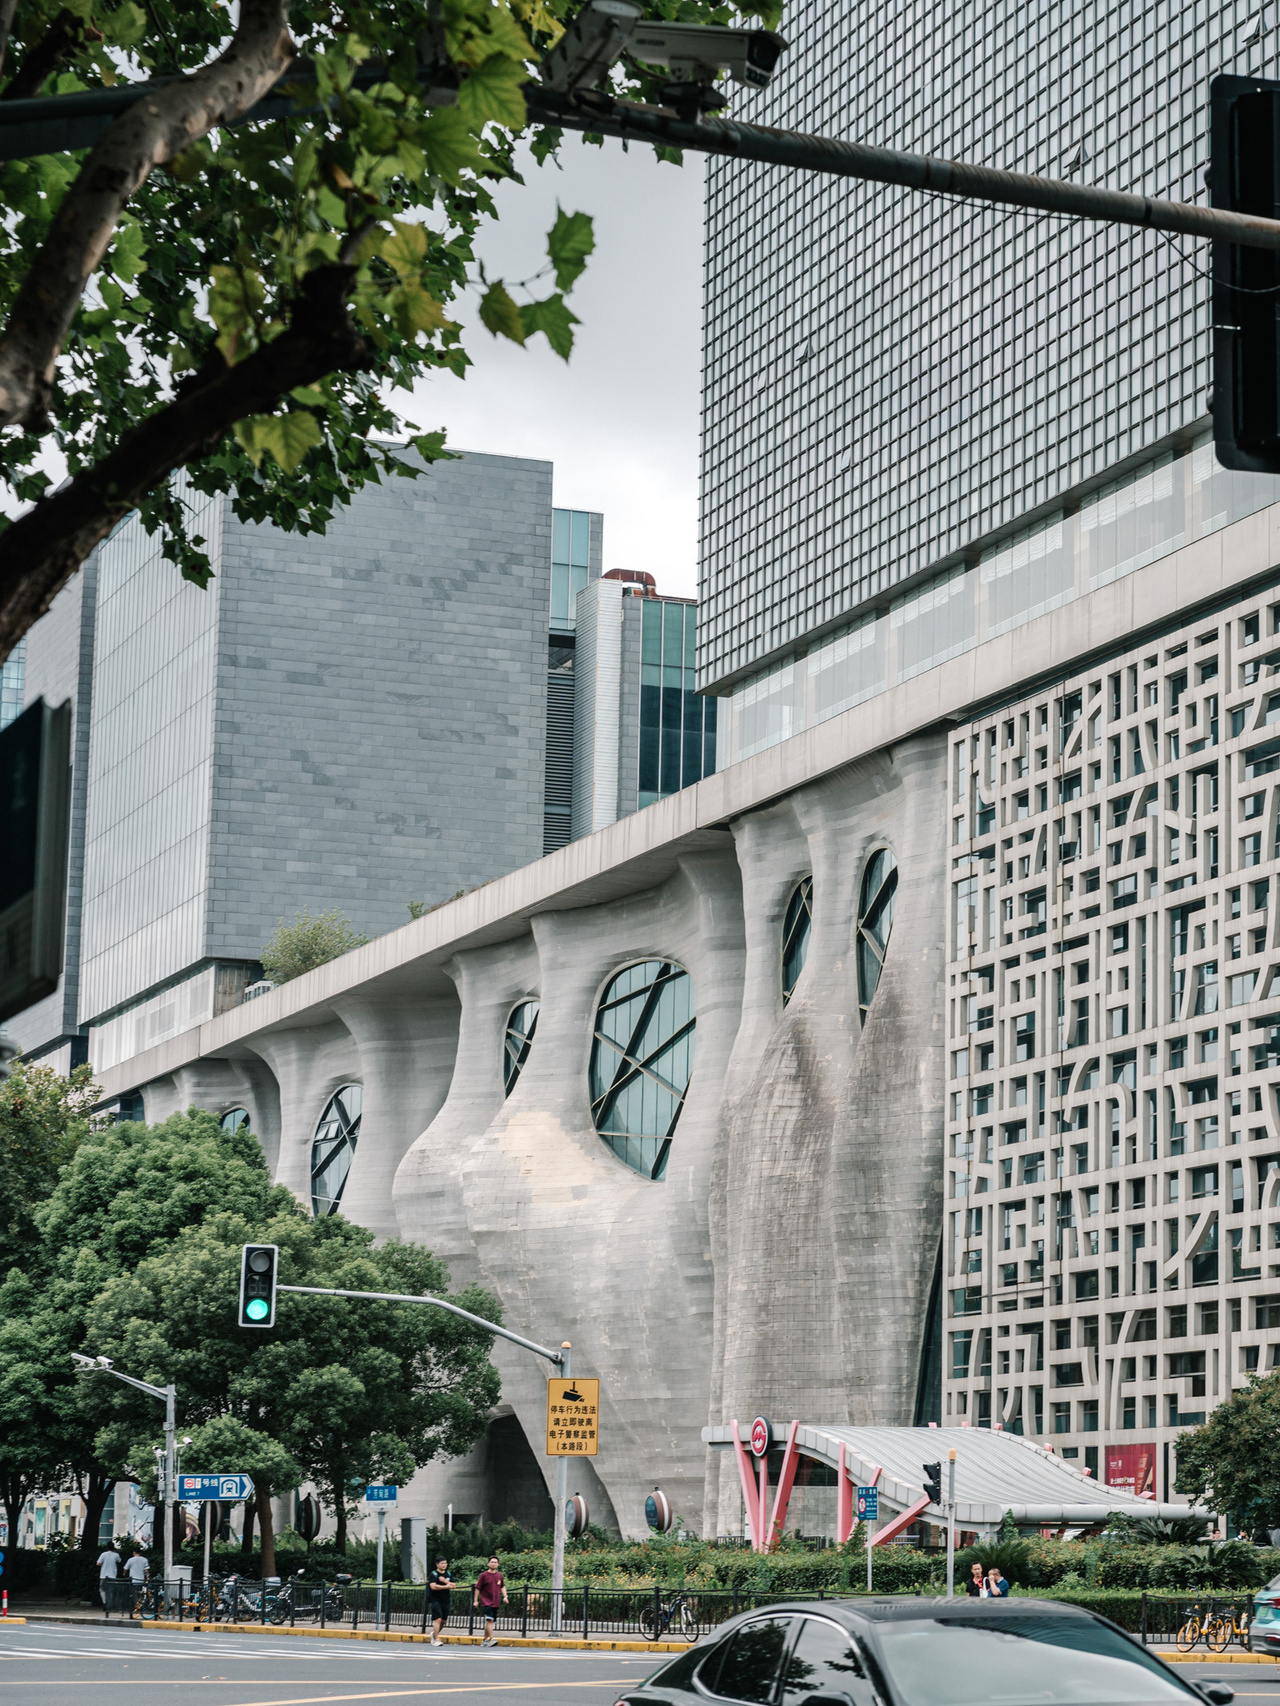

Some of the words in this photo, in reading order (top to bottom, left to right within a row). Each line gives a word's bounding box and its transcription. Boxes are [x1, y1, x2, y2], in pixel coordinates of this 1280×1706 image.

[550, 1405, 597, 1415] 停车行为违法
[549, 1429, 596, 1439] 电子警察监管
